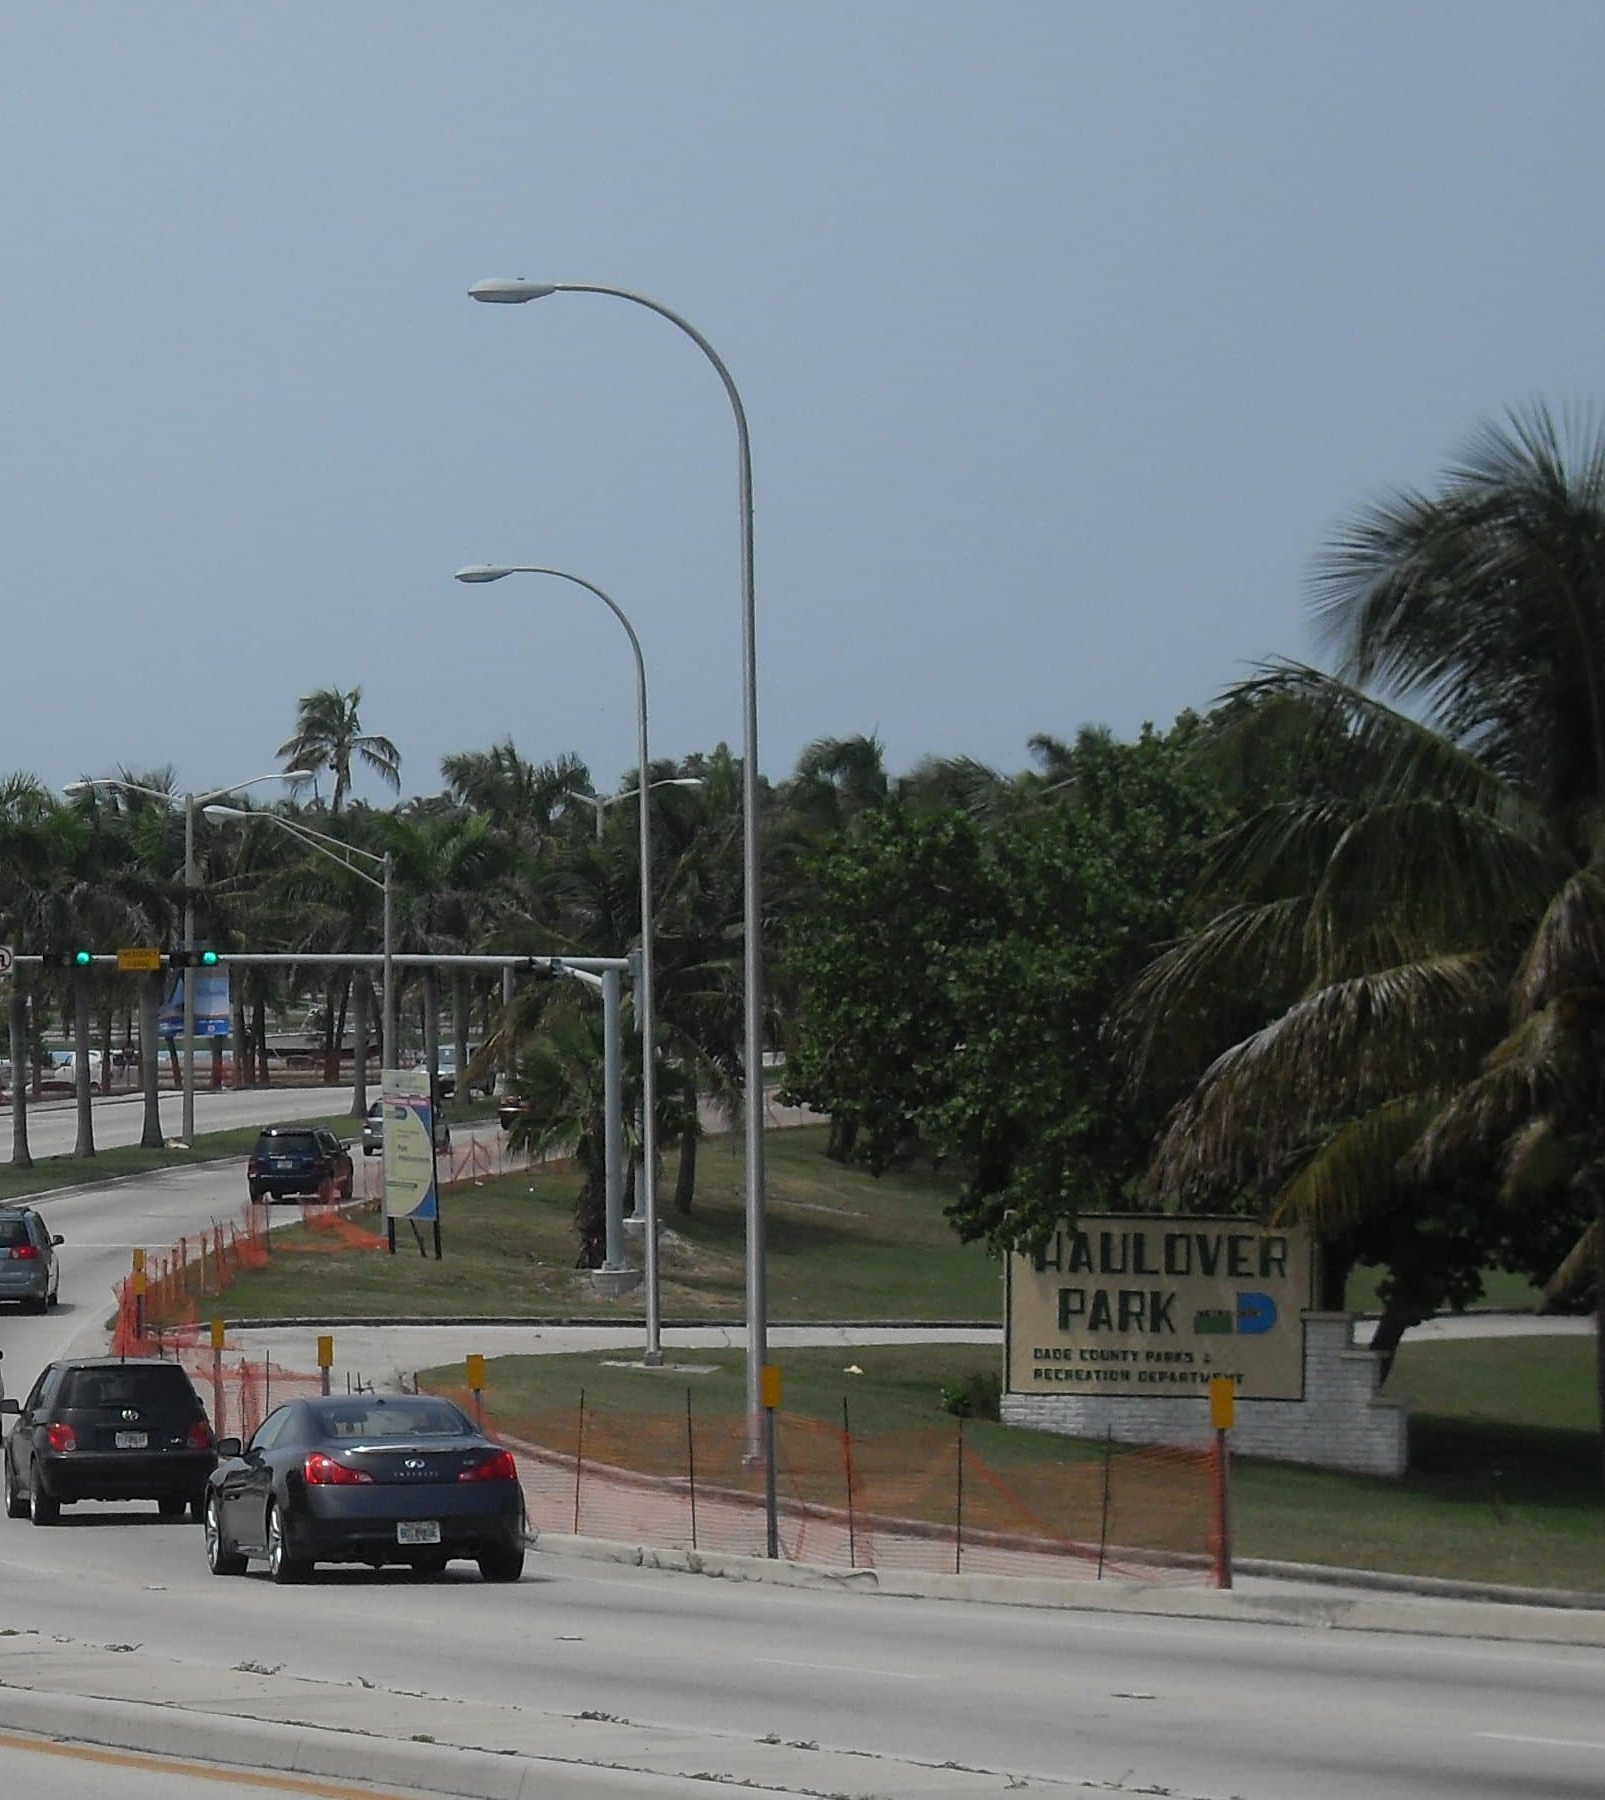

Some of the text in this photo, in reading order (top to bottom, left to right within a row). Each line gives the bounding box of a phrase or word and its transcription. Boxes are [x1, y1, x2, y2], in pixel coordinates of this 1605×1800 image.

[1034, 1231, 1288, 1278] HAULOVER
[1058, 1287, 1177, 1334] PARK
[1033, 1348, 1072, 1361] DADE
[1079, 1349, 1139, 1363] COUNTY
[1146, 1351, 1194, 1364] PARKS
[1033, 1368, 1130, 1382] RECREATION
